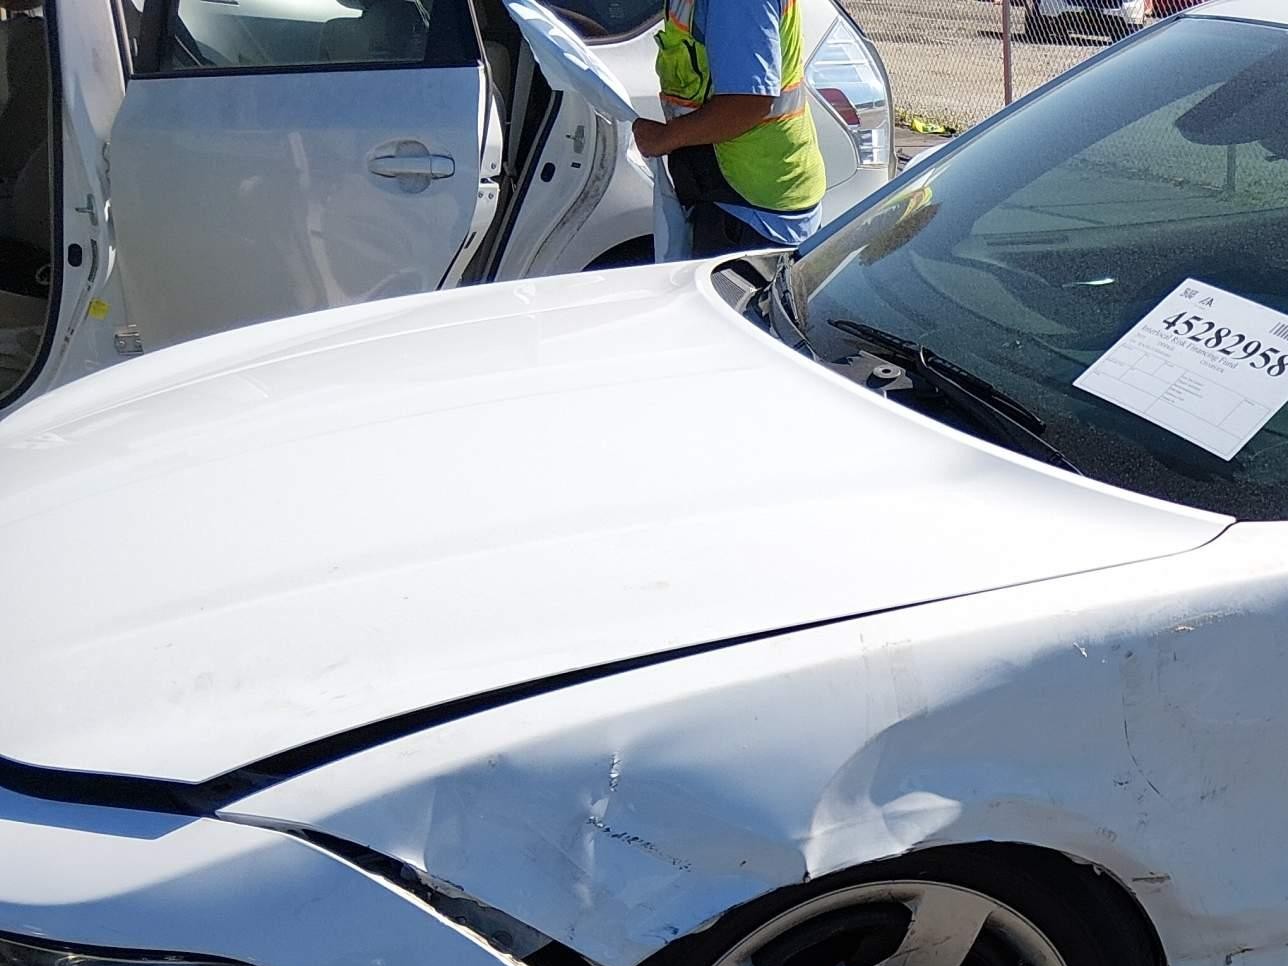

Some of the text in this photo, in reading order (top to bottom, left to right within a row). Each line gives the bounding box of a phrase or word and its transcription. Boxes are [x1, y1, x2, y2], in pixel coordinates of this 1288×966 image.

[1170, 335, 1187, 347] Risk
[1186, 341, 1218, 360] Financing
[1217, 354, 1240, 370] Fund
